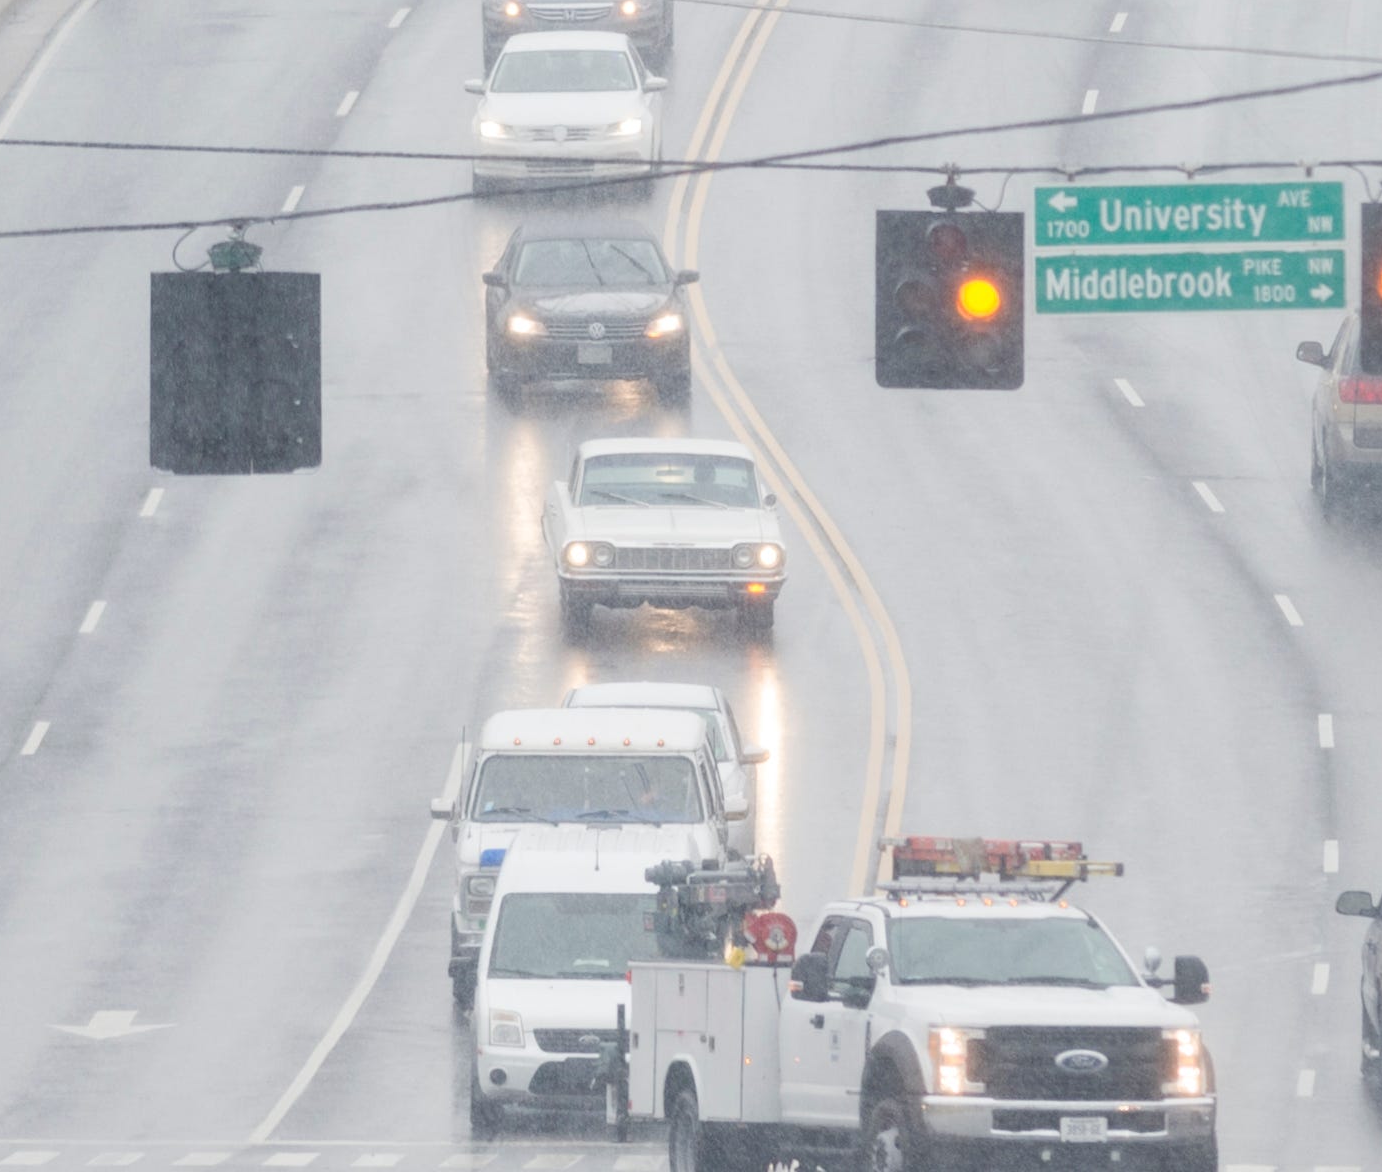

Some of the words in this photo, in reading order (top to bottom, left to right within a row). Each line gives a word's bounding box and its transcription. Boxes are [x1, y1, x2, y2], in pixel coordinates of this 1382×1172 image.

[1046, 221, 1090, 239] 1700
[1307, 216, 1334, 234] NW
[1099, 196, 1267, 237] University
[1277, 189, 1312, 208] AVE
[1045, 266, 1233, 301] Middlebrook
[1242, 258, 1283, 276] PIKE
[1307, 257, 1334, 274] NW
[1252, 284, 1296, 303] 1800
